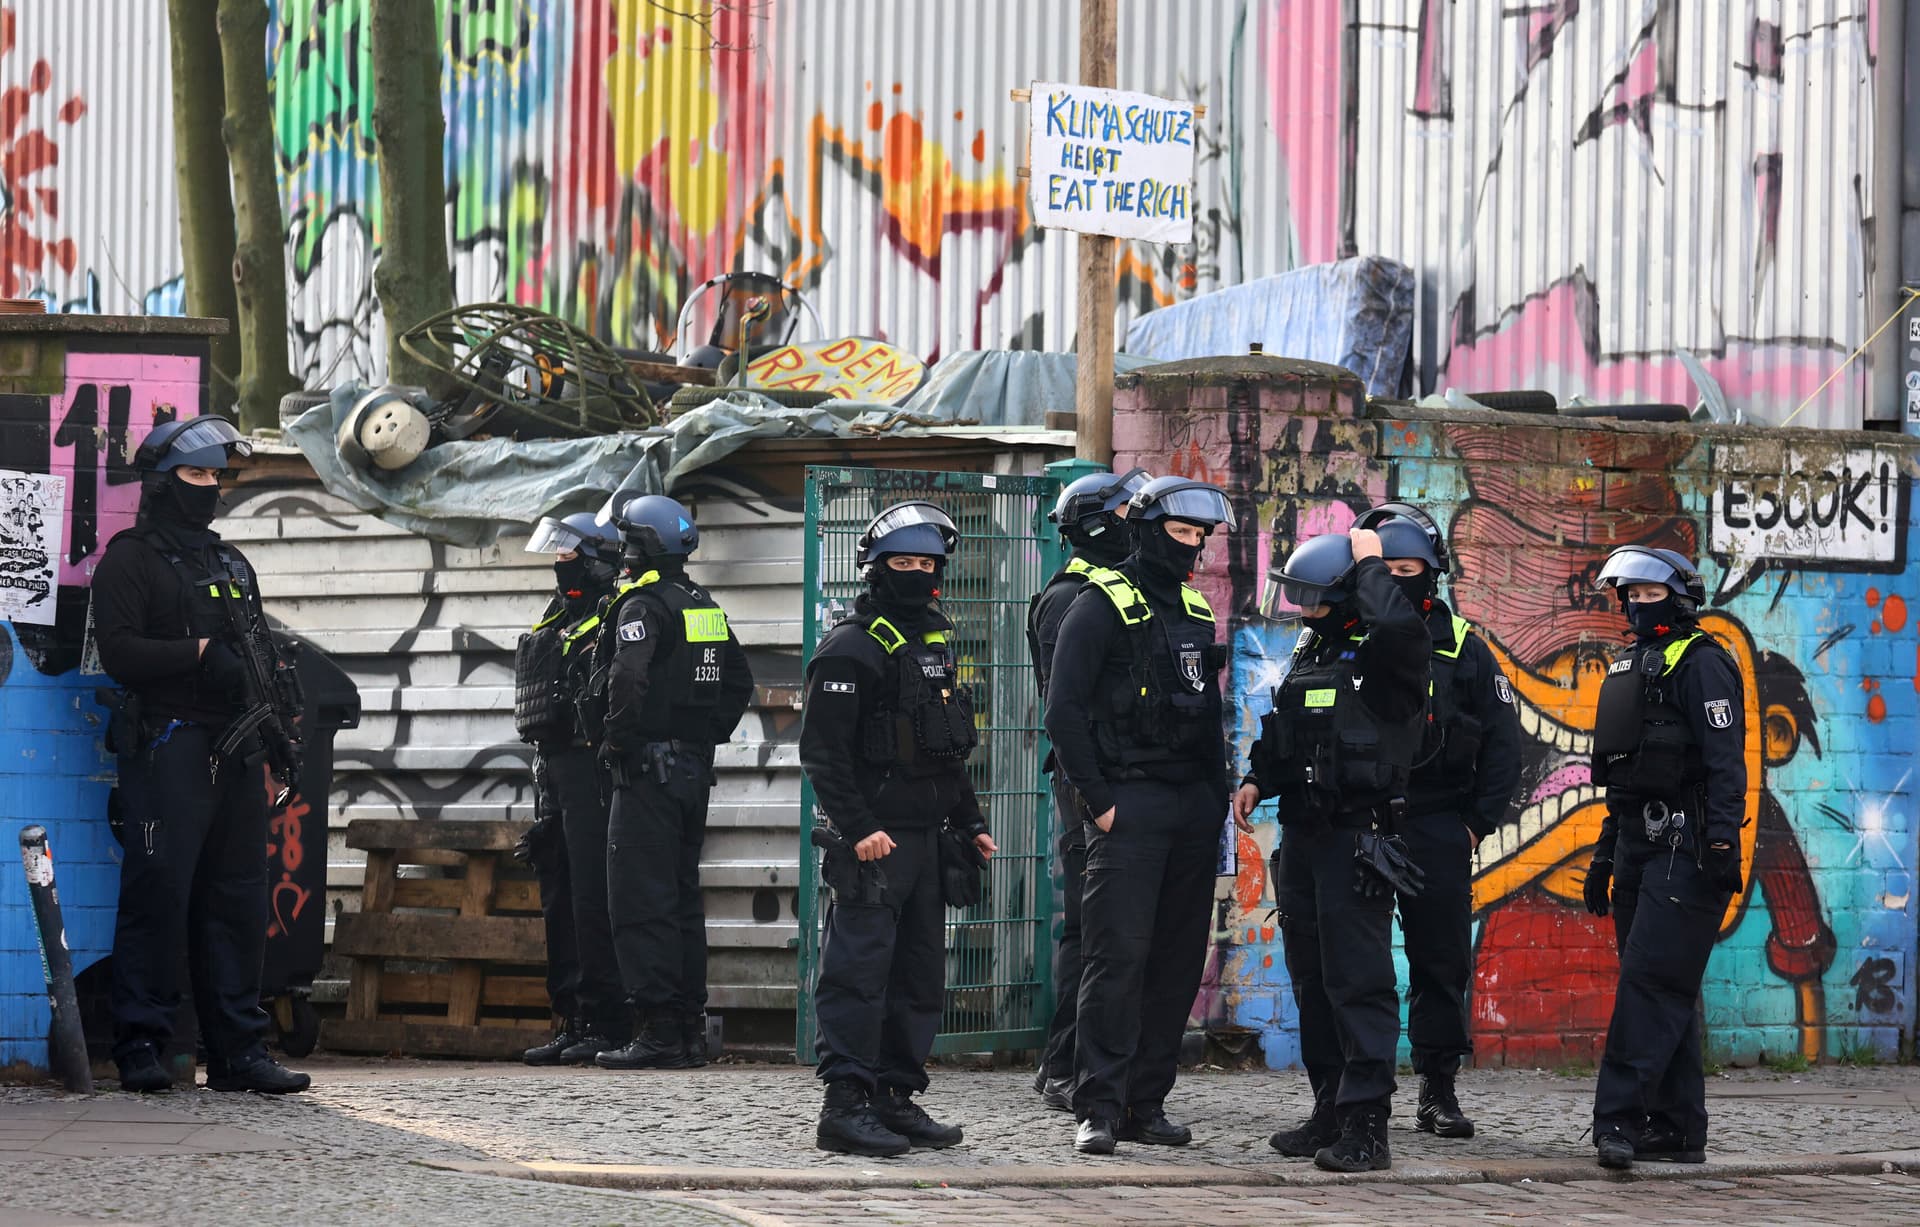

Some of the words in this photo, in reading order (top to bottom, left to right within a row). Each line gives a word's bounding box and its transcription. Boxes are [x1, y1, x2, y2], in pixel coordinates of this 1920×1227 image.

[1046, 94, 1192, 145] KLIMASCHUTZ
[1048, 174, 1098, 212] EAT
[687, 614, 726, 636] POLIZE
[703, 648, 716, 663] BE
[694, 666, 720, 681] 13231
[1608, 659, 1632, 675] POLIZEI
